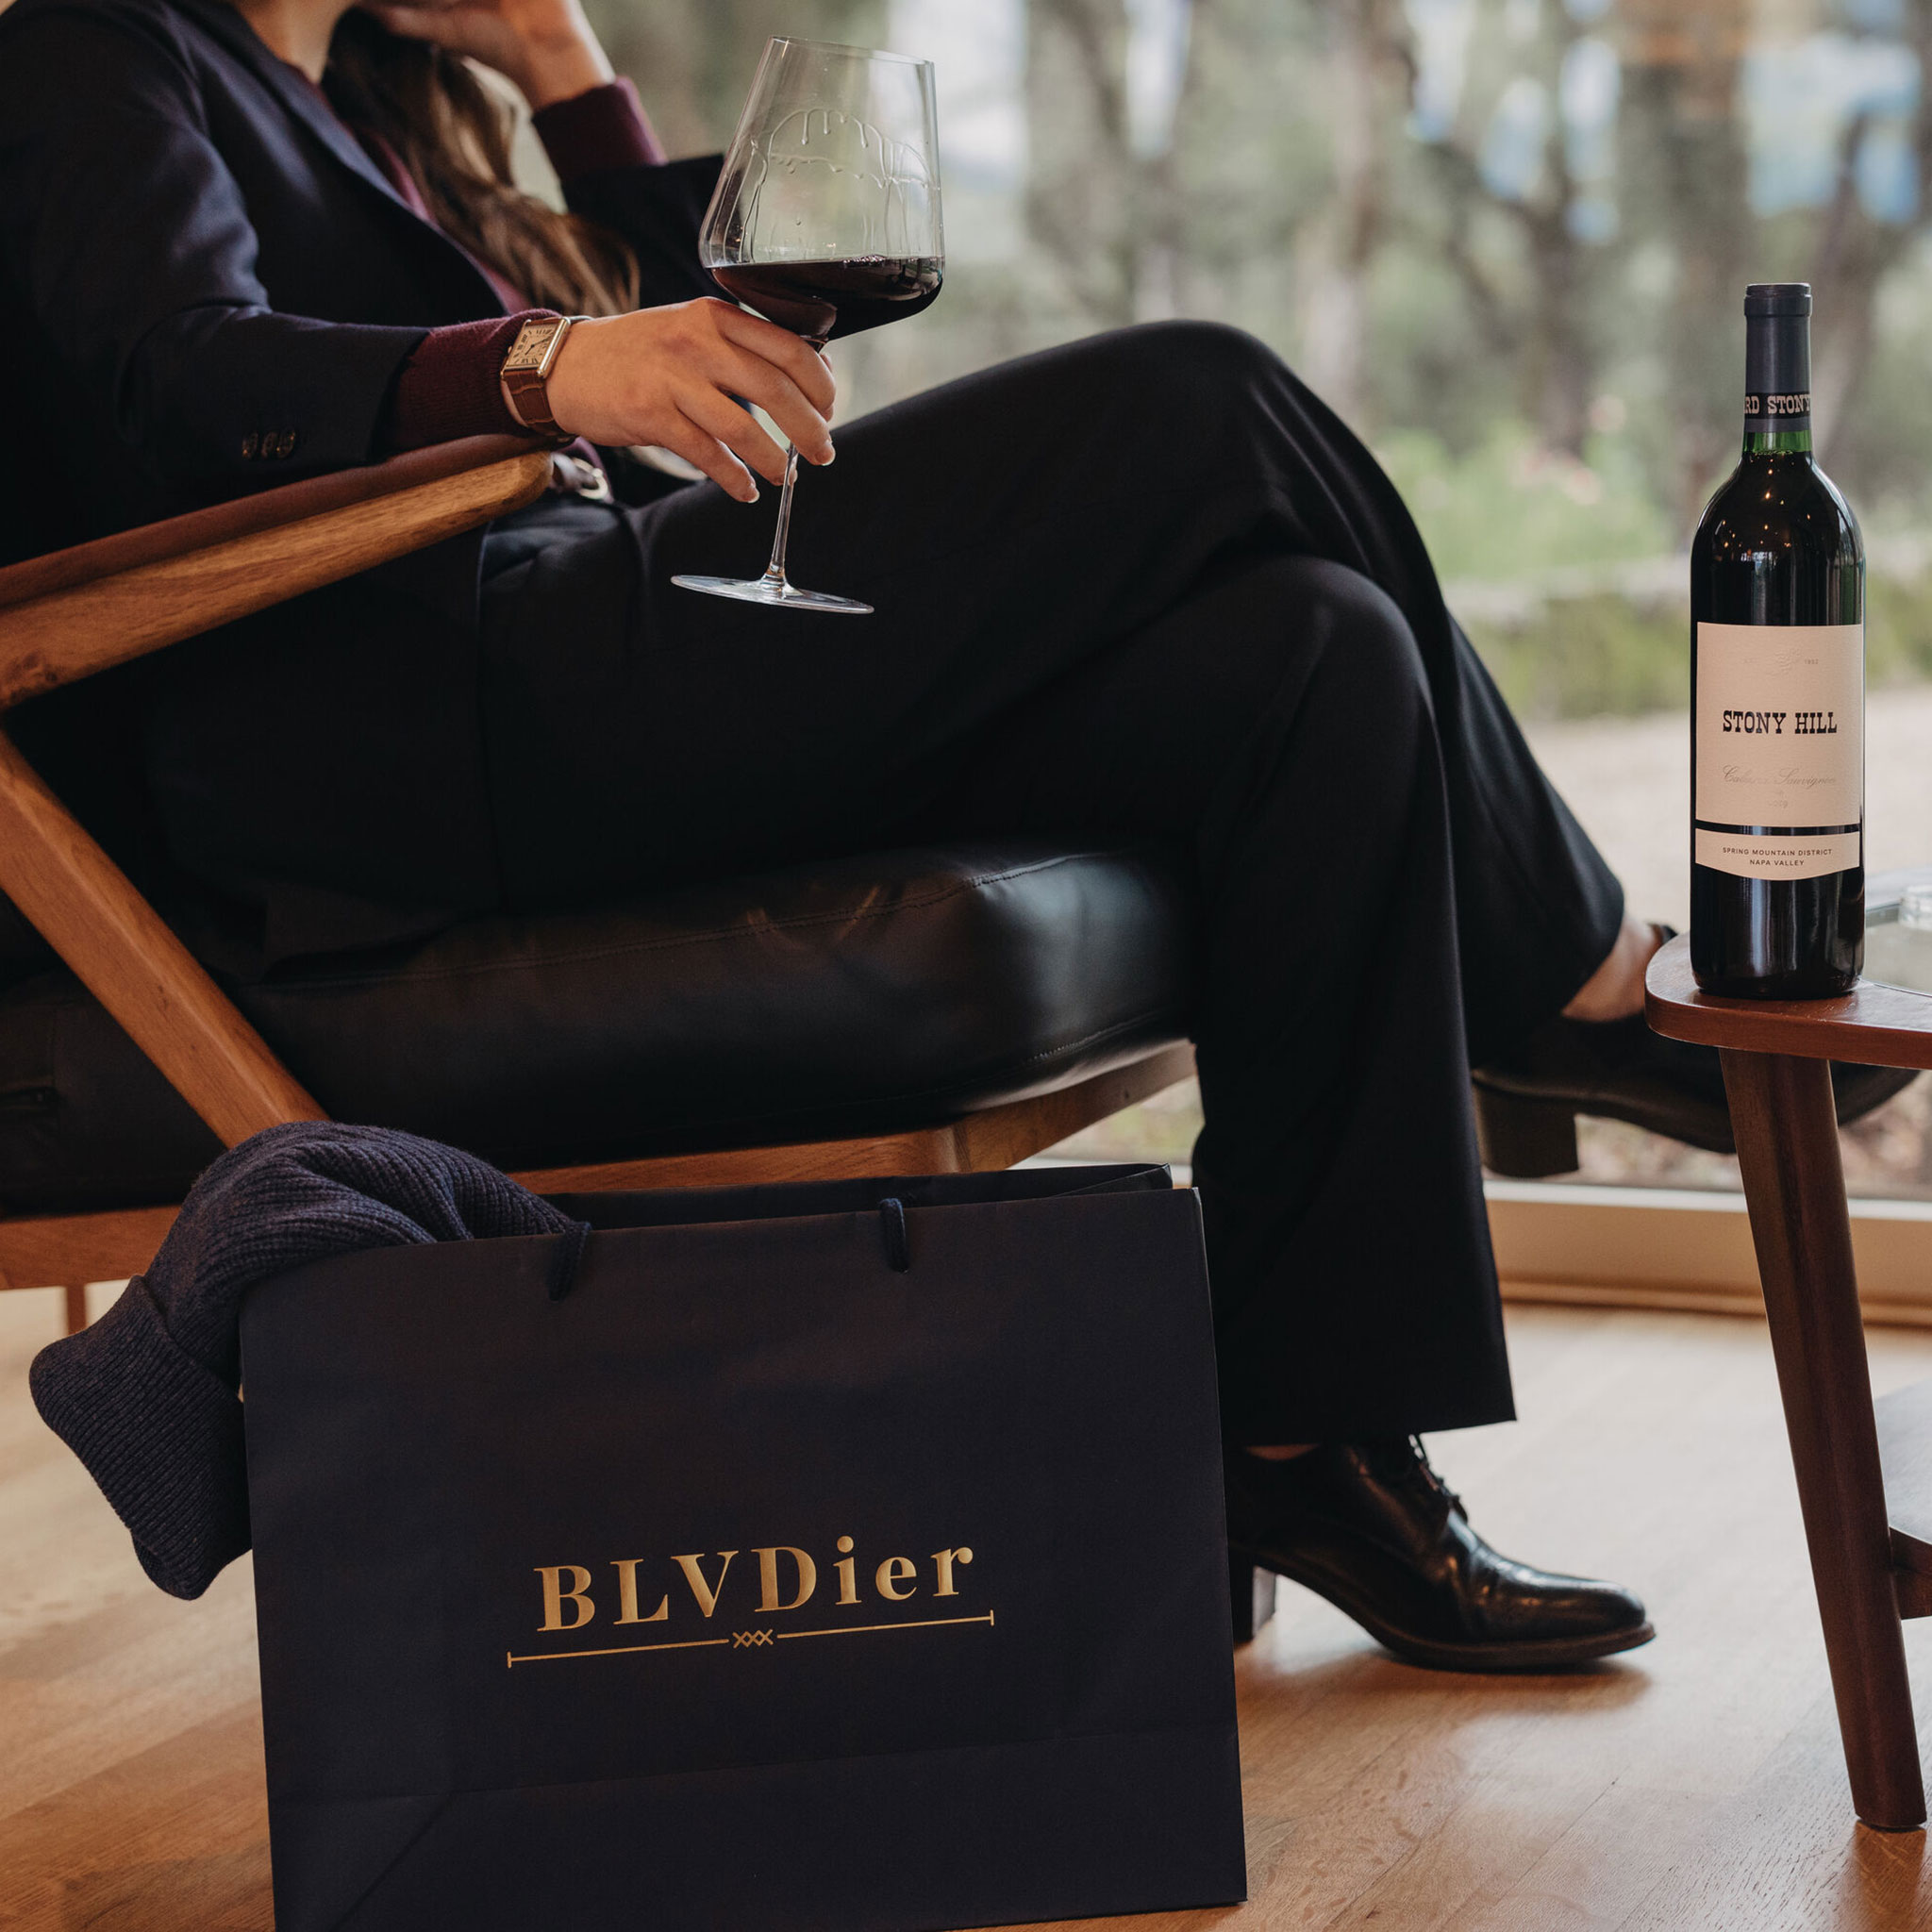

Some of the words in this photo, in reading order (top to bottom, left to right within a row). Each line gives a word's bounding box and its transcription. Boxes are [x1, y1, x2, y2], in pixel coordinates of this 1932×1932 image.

[1767, 393, 1810, 414] STONY
[1723, 710, 1787, 734] STONY
[1794, 711, 1838, 734] HILL
[1723, 765, 1770, 784] Cabe
[1723, 847, 1750, 856] SPRING
[533, 1535, 974, 1633] BLVDier
